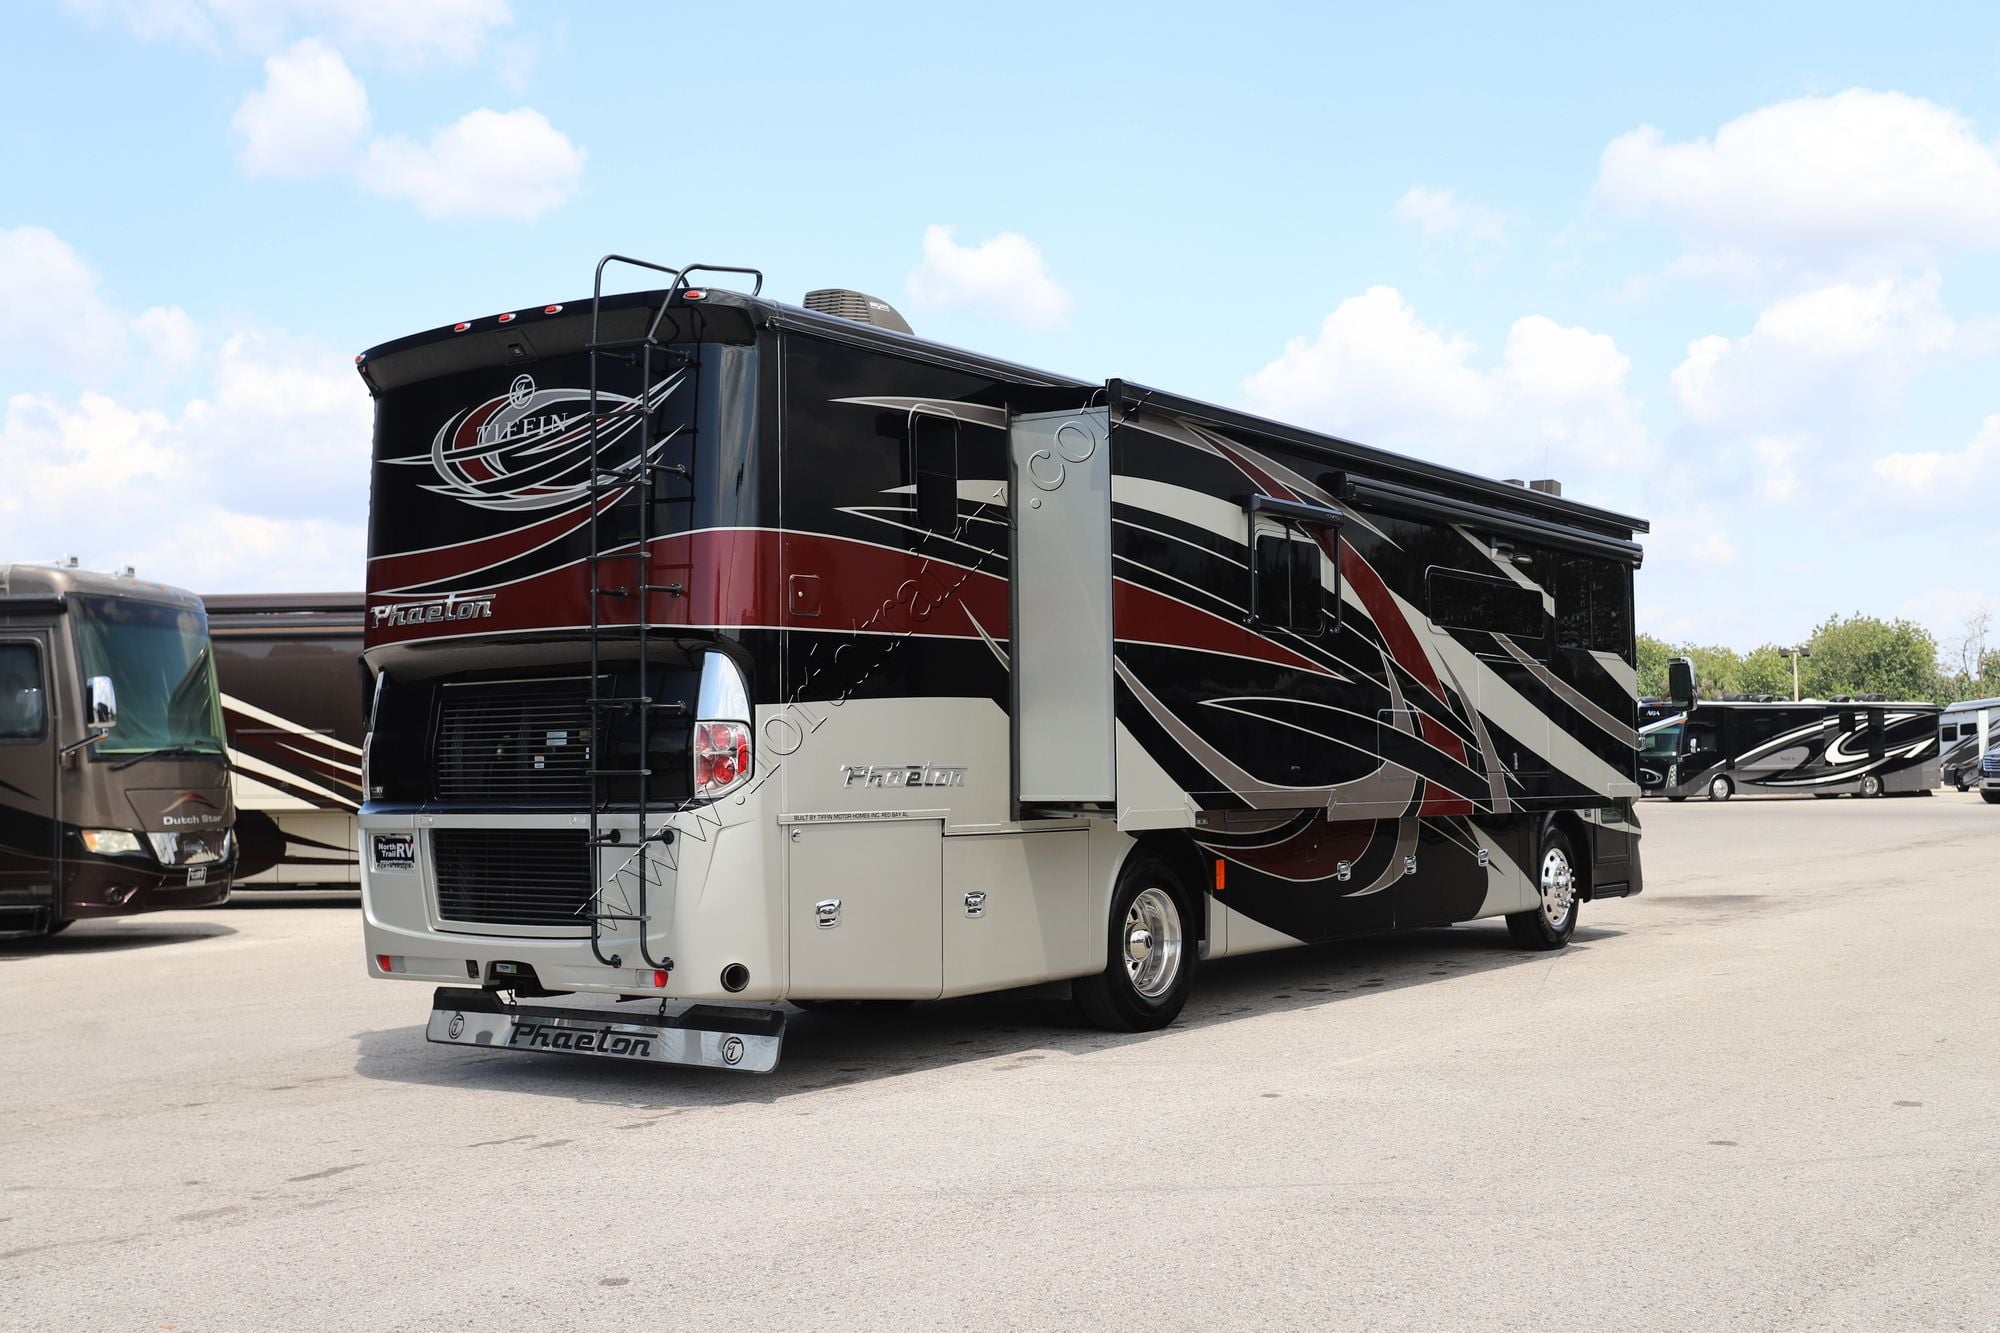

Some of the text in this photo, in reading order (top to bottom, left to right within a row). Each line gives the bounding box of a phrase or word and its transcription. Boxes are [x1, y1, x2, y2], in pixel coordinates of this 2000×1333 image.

[476, 412, 568, 444] TIFFIN
[370, 593, 496, 629] Phaeton
[839, 761, 968, 788] Phaeton
[163, 813, 222, 825] Dutch Star
[396, 843, 414, 858] RV
[509, 1023, 658, 1056] Phaeton
